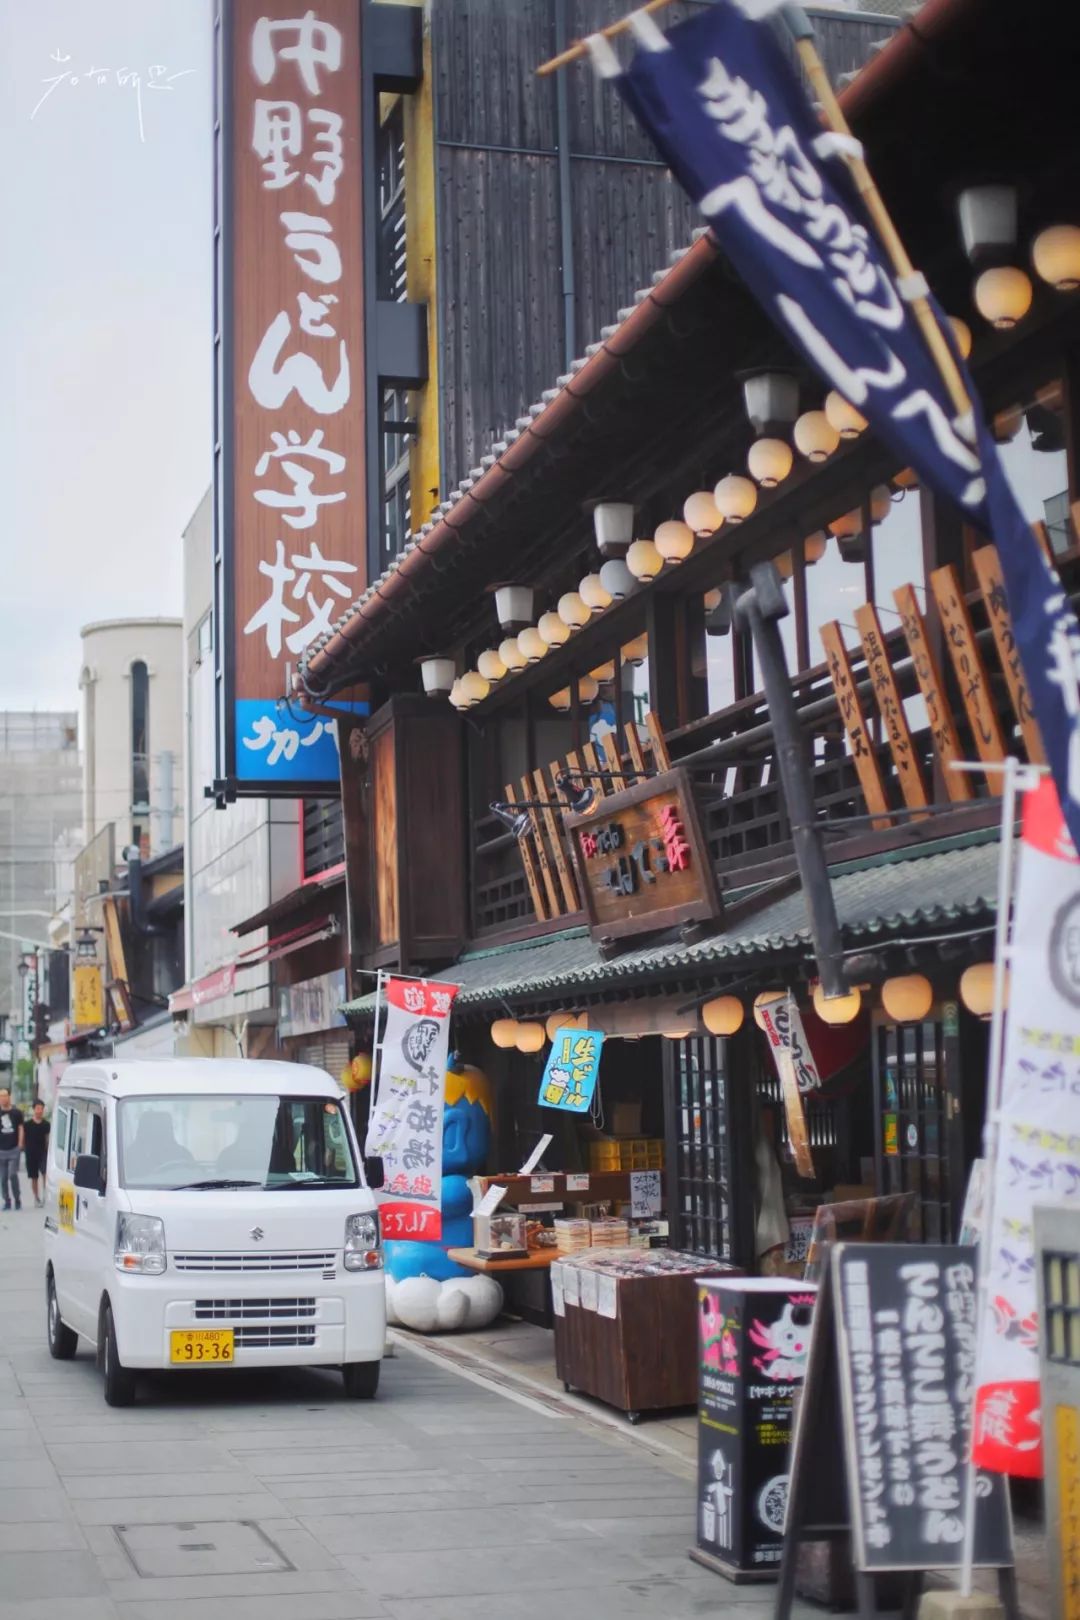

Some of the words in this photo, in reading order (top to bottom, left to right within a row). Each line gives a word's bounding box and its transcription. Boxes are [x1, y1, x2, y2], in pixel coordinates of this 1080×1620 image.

[246, 10, 358, 659] 中野うどん学校
[571, 1035, 596, 1107] 生ビール
[184, 1343, 230, 1360] 93-36
